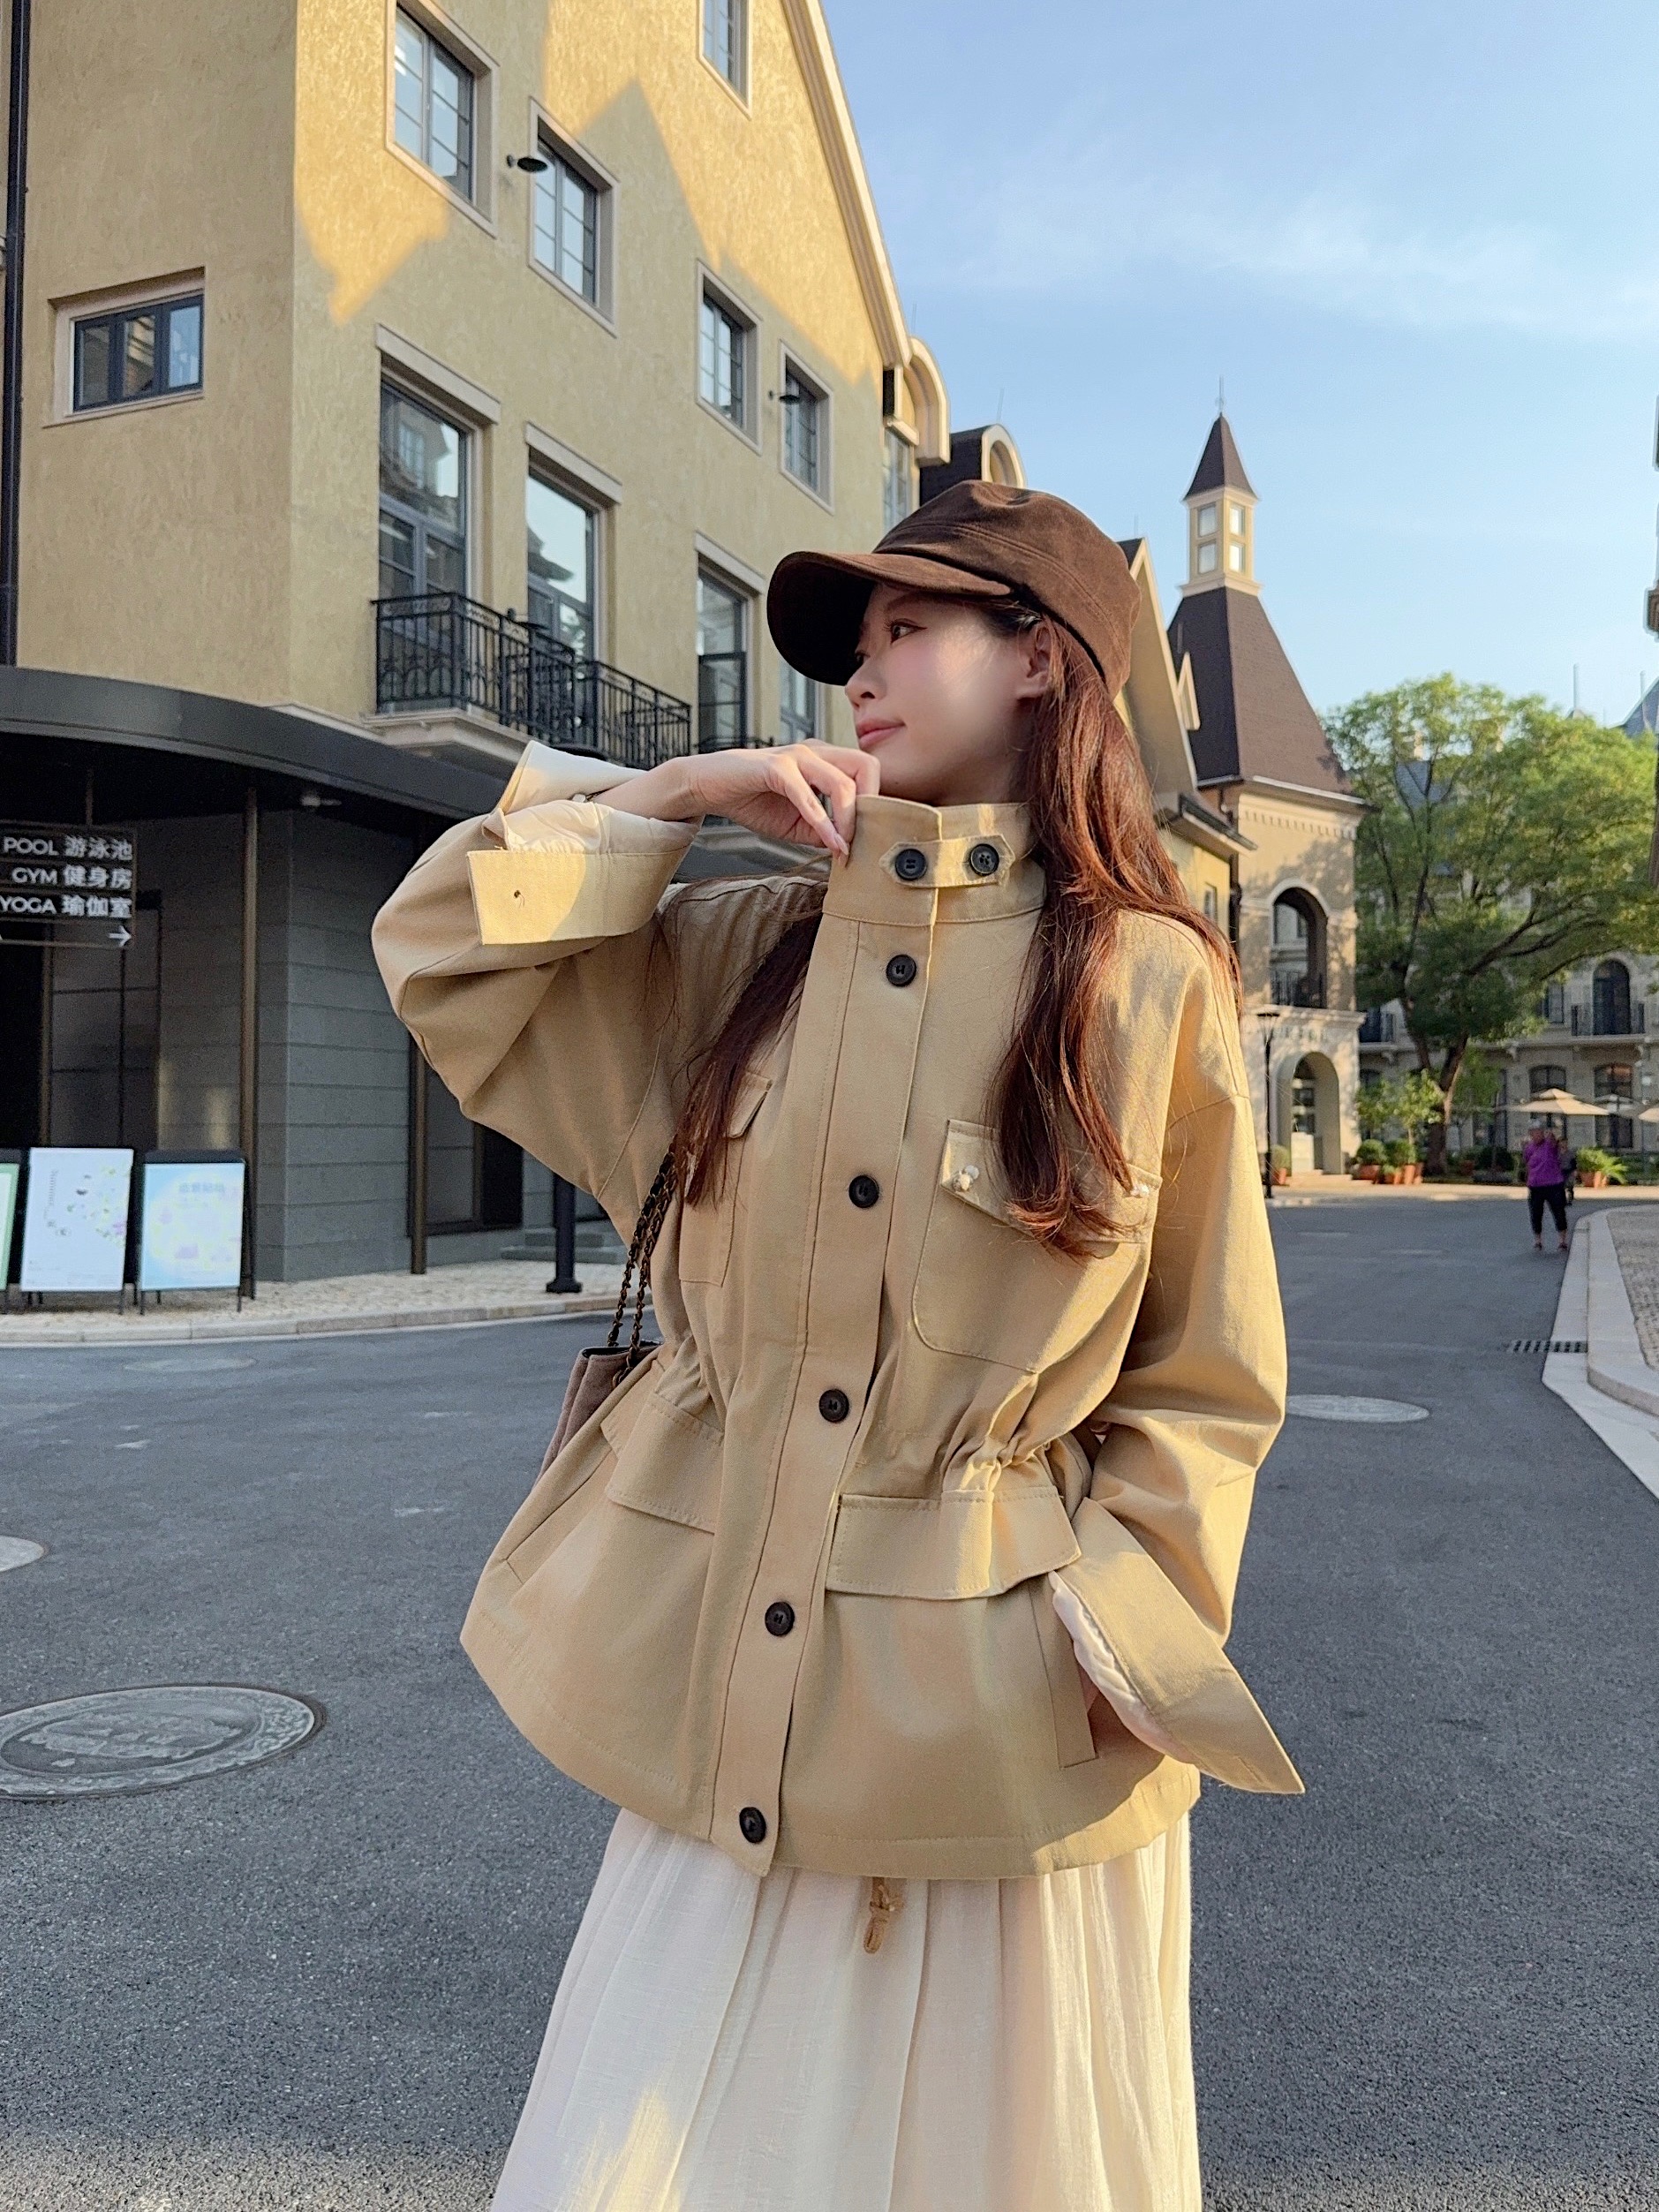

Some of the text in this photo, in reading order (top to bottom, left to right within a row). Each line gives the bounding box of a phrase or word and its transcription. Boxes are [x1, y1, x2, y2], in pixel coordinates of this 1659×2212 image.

[4, 834, 132, 861] POOL 游泳池
[11, 864, 132, 889] GYM 健身房
[0, 894, 132, 918] YOGA 瑜伽室
